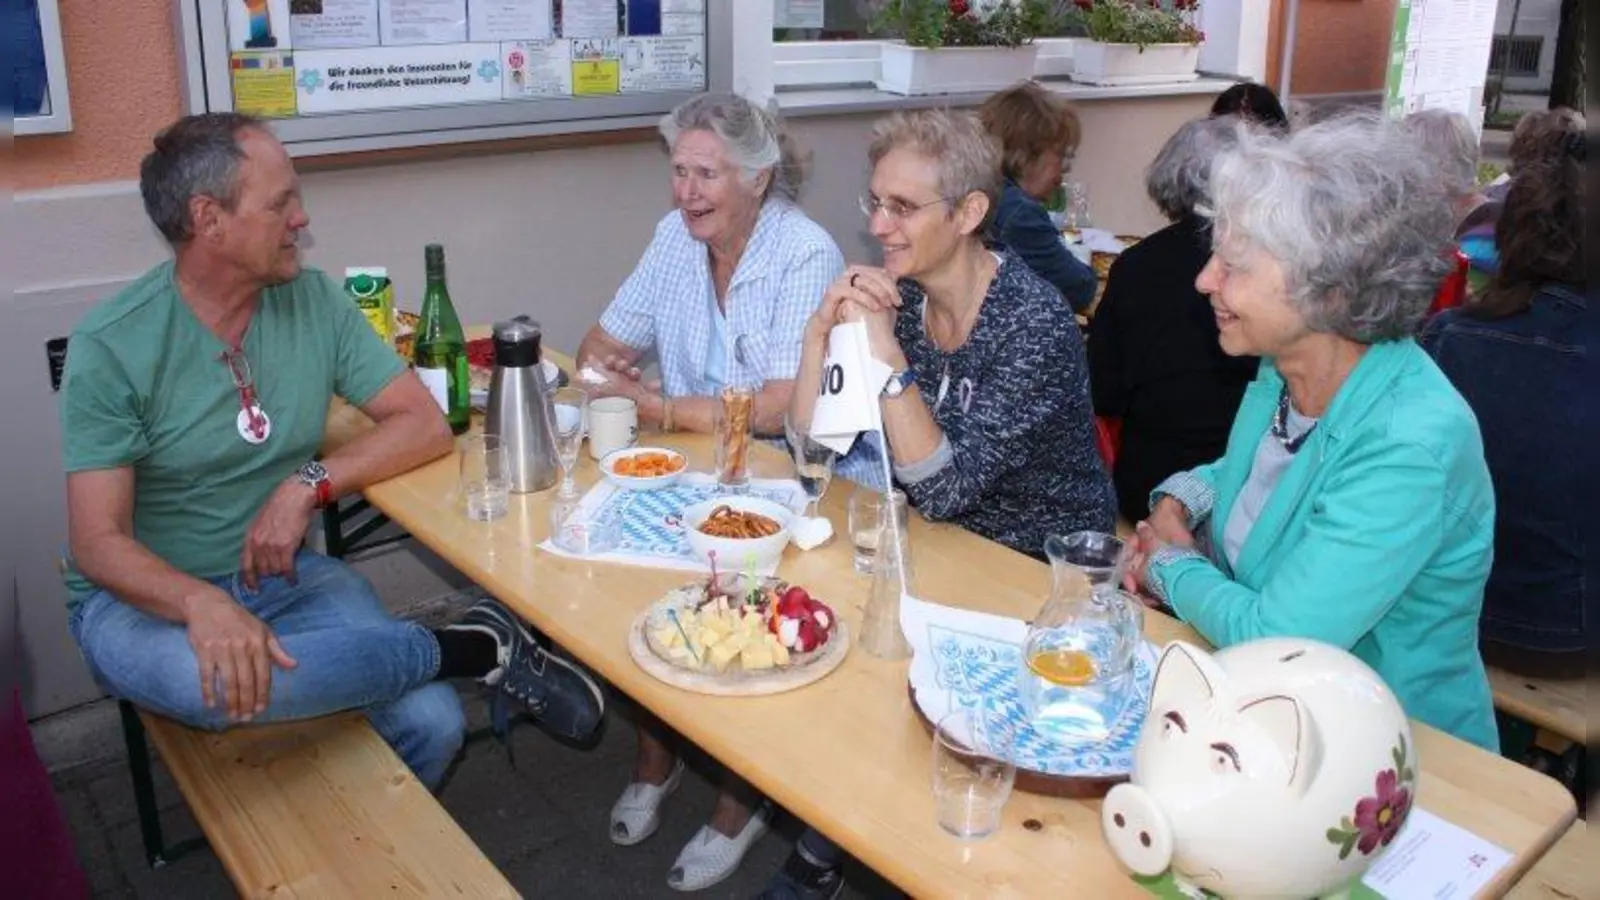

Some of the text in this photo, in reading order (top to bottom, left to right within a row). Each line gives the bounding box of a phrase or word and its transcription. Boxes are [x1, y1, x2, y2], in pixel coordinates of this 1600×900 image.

[328, 66, 345, 77] Wir
[349, 66, 385, 76] danken
[387, 64, 405, 74] den
[458, 60, 473, 70] für
[328, 74, 471, 91] die freundliche Unterstützung!
